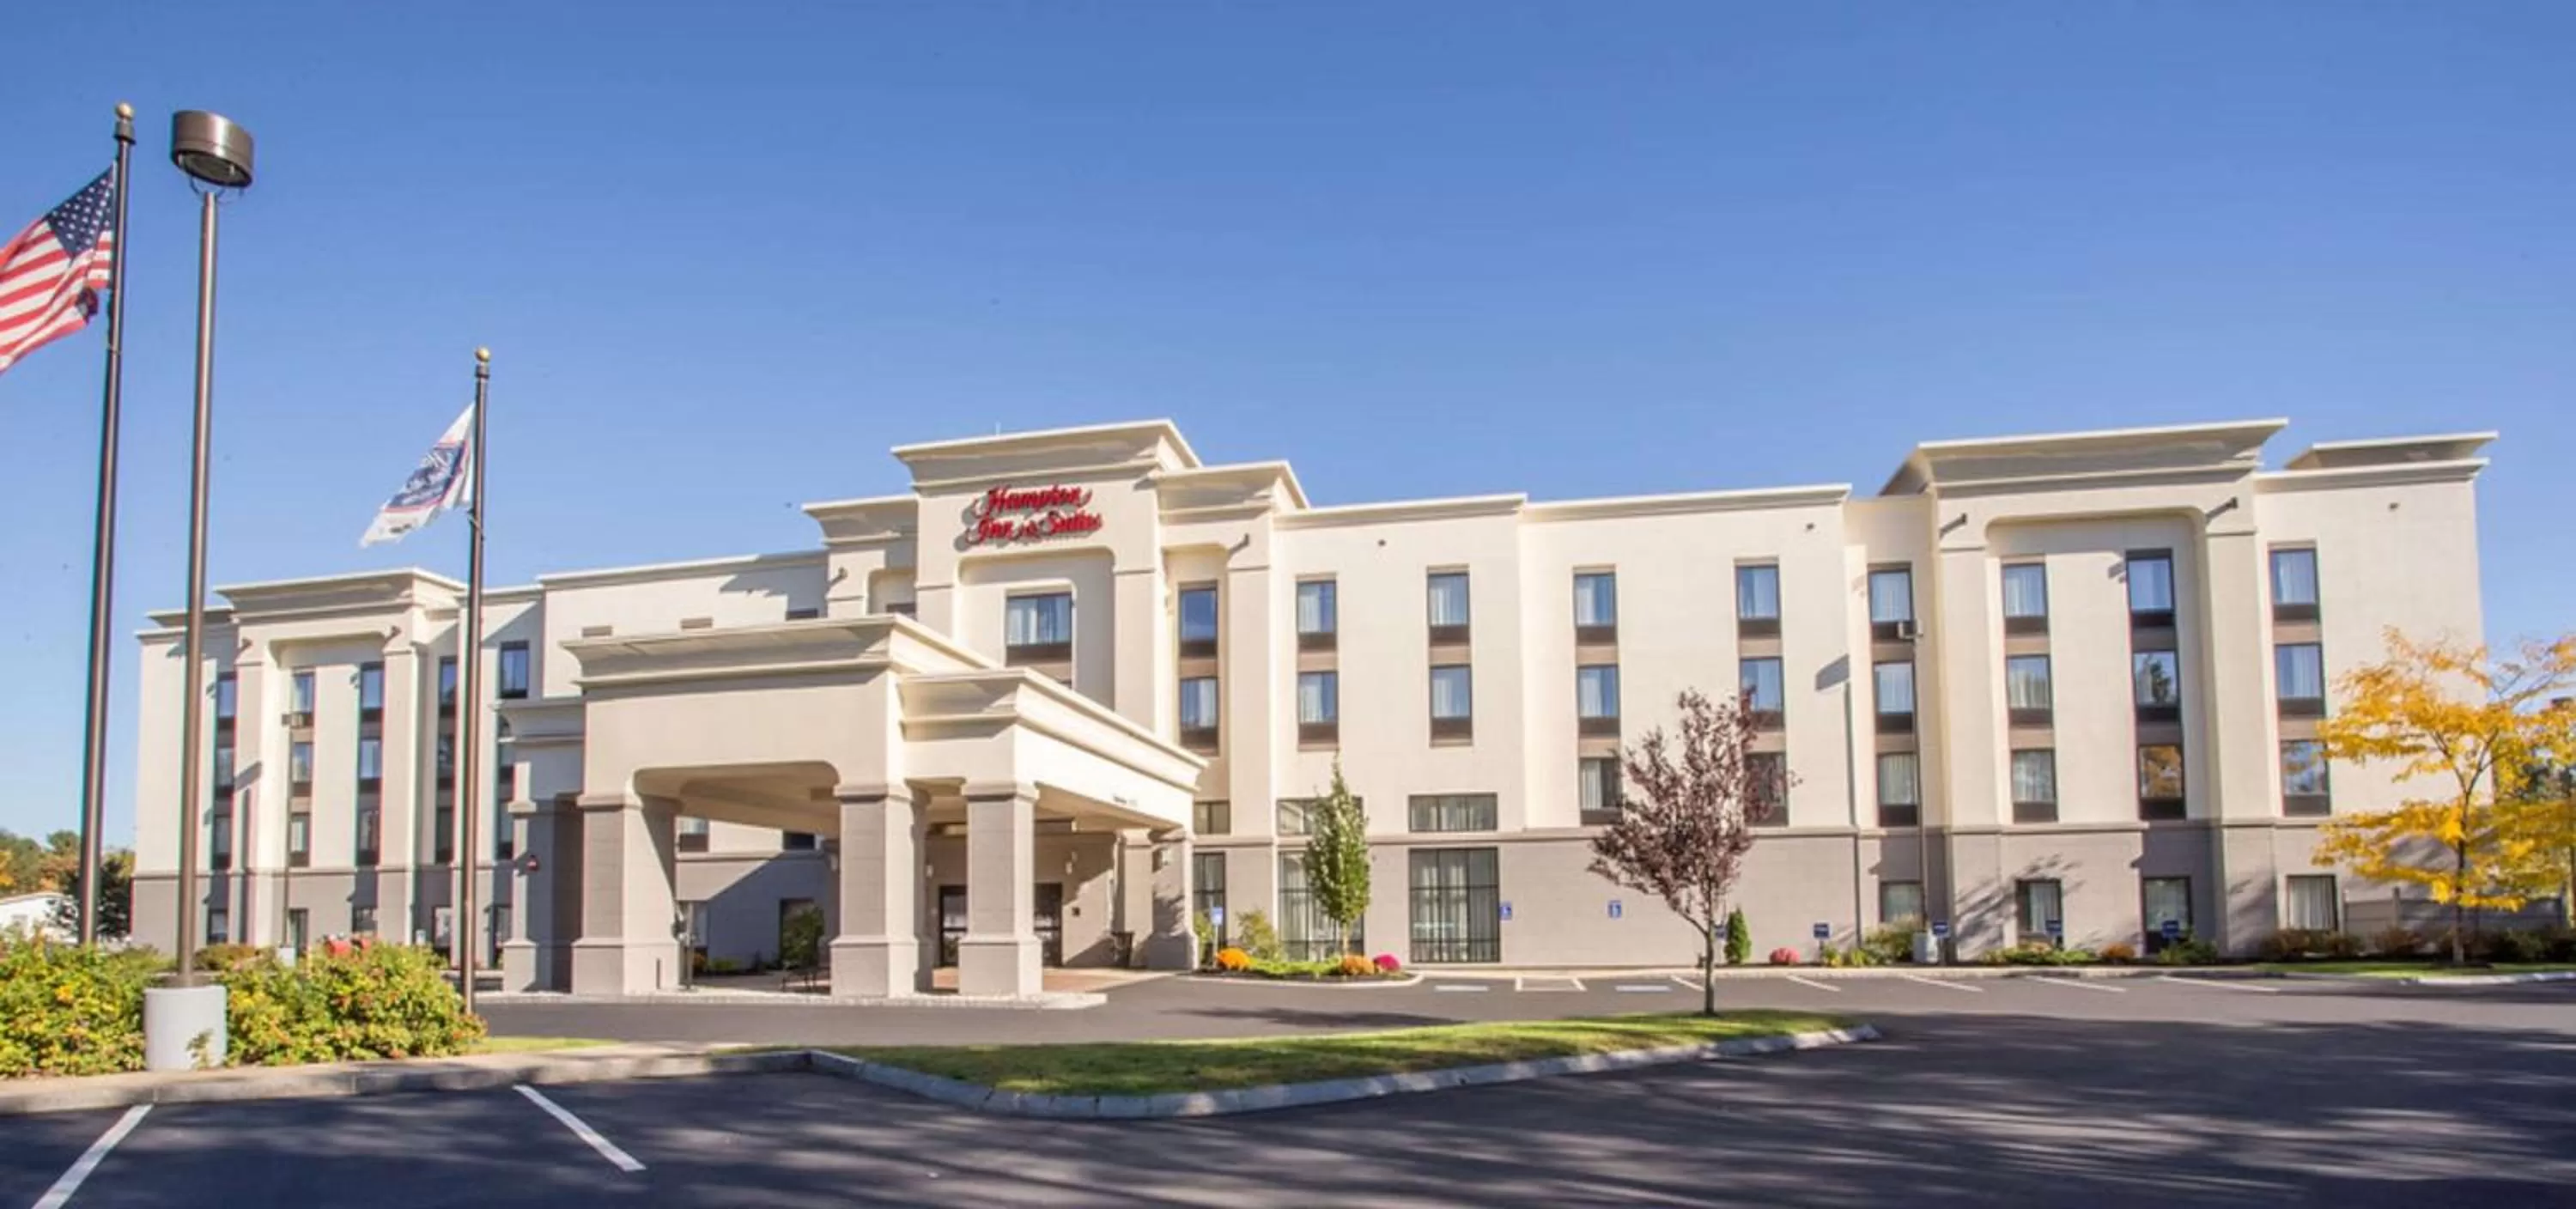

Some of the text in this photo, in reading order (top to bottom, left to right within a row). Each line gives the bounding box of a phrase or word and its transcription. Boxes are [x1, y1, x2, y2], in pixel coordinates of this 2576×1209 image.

[972, 484, 1092, 518] Hampton
[965, 517, 1020, 544] Inn
[1039, 509, 1103, 537] Suites
